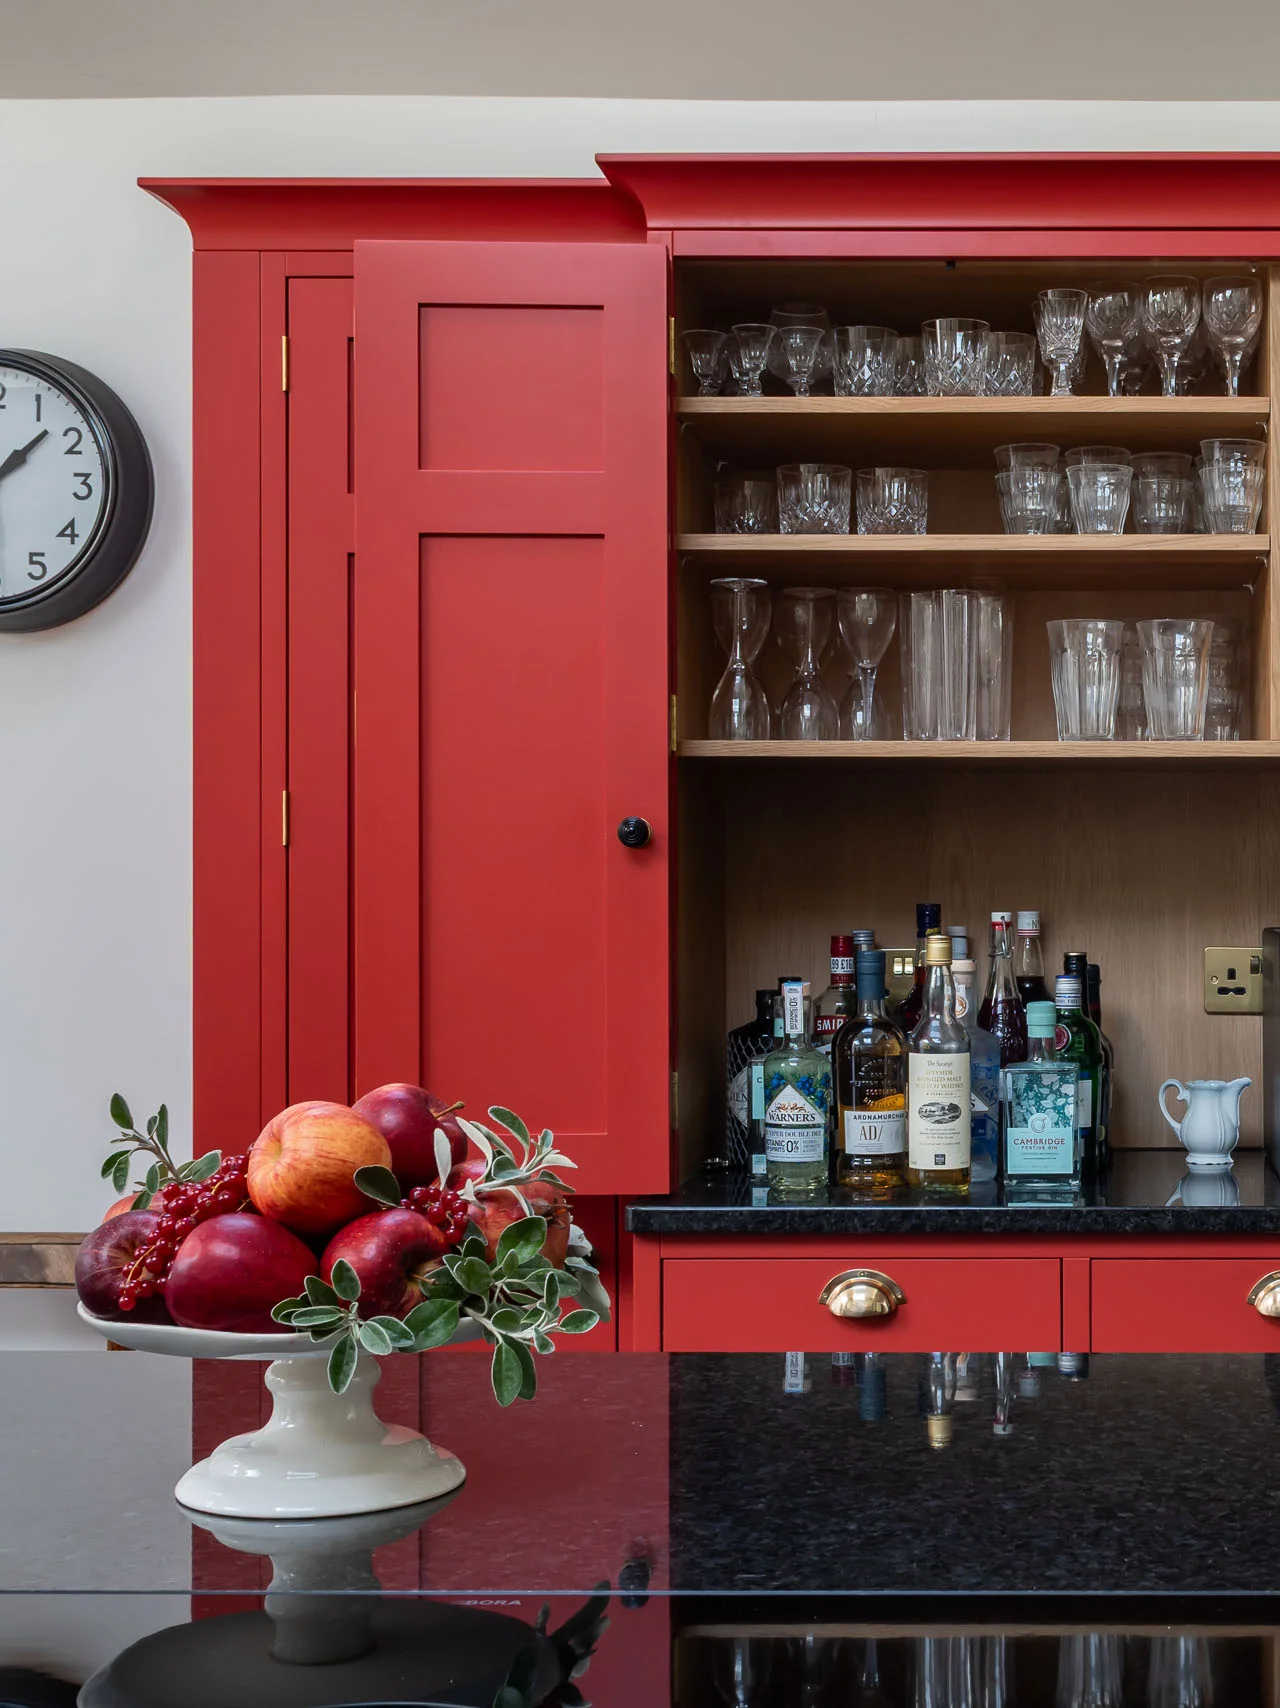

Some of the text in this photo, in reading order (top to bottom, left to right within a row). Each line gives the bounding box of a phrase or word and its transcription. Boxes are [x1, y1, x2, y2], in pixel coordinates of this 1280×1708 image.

[35, 394, 42, 422] 1
[63, 427, 83, 455] 2
[72, 472, 93, 501] 3
[56, 517, 80, 545] 4
[27, 552, 47, 581] 5
[1013, 1138, 1066, 1146] CAMBRIDGE
